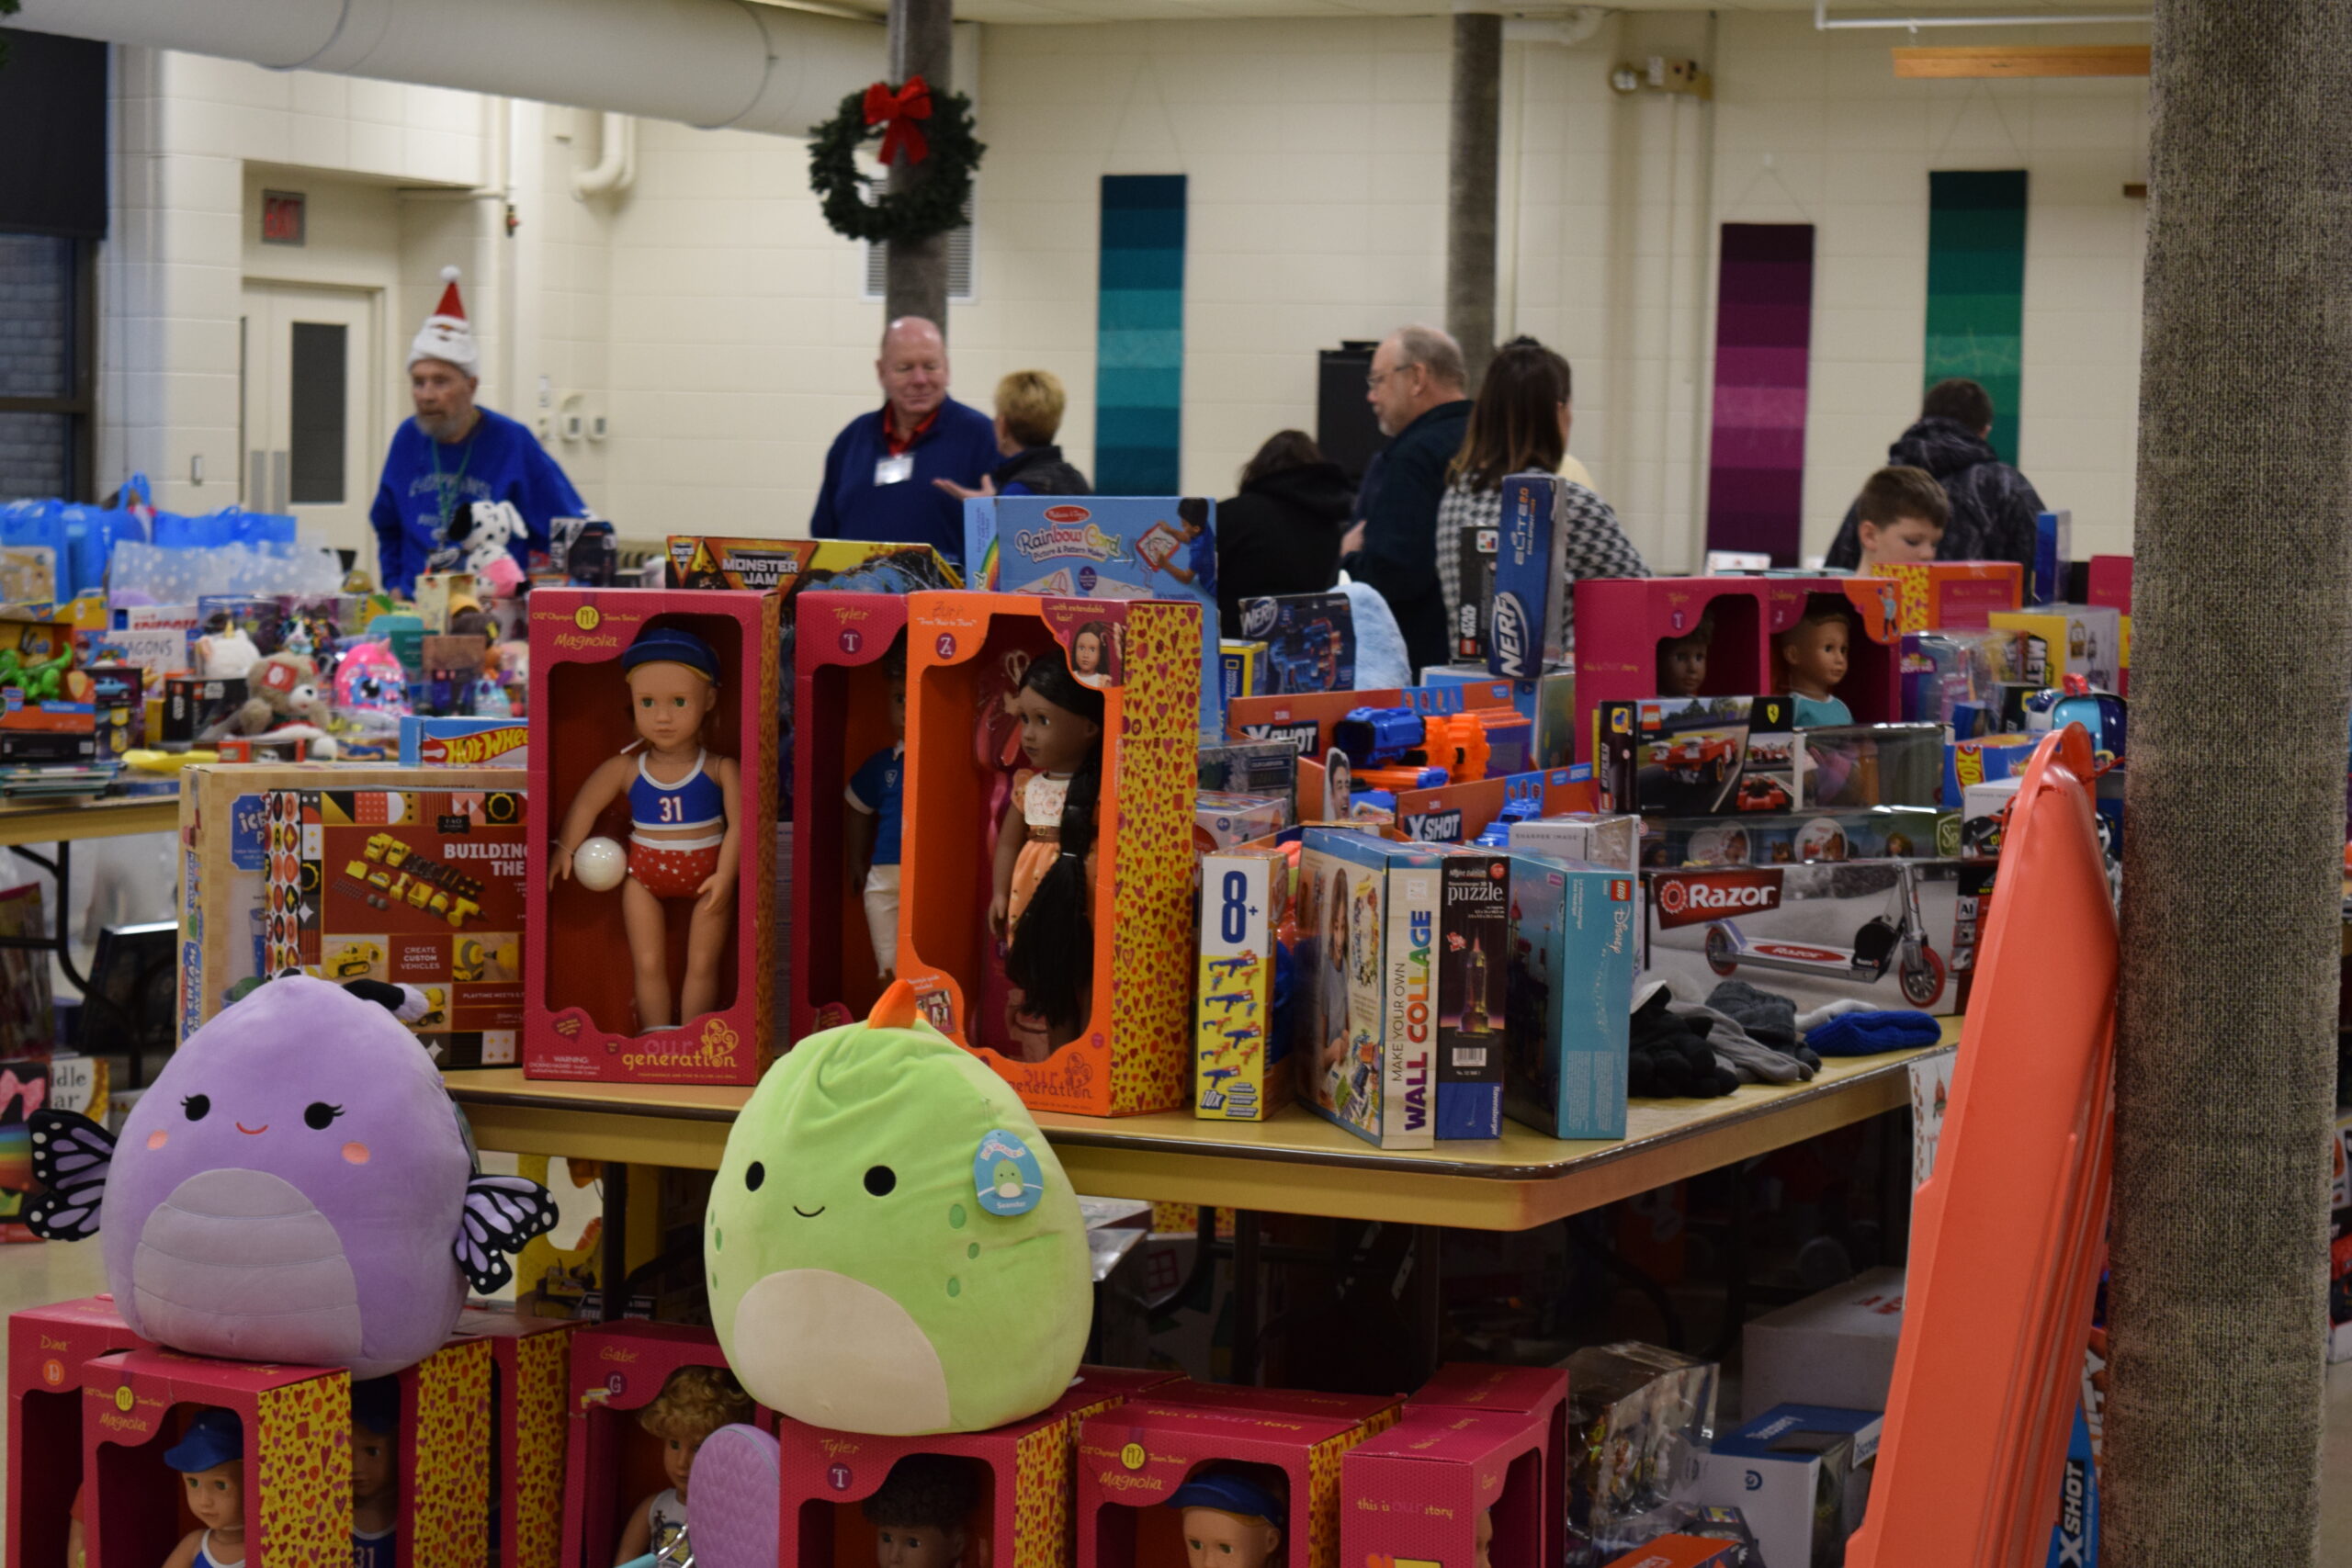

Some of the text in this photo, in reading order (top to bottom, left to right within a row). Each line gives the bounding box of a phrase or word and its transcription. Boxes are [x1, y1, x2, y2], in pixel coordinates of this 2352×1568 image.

[1017, 525, 1082, 553] Rainbow
[722, 558, 798, 573] MONSTER
[743, 573, 778, 585] JAM
[833, 606, 869, 625] Tyler
[1244, 601, 1277, 634] NERF
[553, 633, 618, 649] Magnolia
[842, 634, 859, 651] T
[939, 637, 952, 654] Z
[1495, 595, 1524, 677] NERF
[442, 736, 483, 762] HOT
[659, 795, 683, 822] 31
[491, 861, 526, 875] THE
[1448, 882, 1503, 906] puzzle
[1617, 880, 1625, 899] LEGO
[1690, 884, 1777, 908] Razor
[1772, 946, 1823, 958] Razor
[1392, 963, 1405, 1081] MAKE YOUR OWN
[1405, 910, 1431, 1131] WALL COLLAGE
[644, 1040, 694, 1056] our
[622, 1050, 738, 1071] generation
[600, 1346, 639, 1363] Gabe
[609, 1375, 622, 1393] G
[99, 1413, 147, 1432] Magnolia
[820, 1438, 860, 1459] Tyler
[832, 1468, 848, 1487] T
[1099, 1471, 1164, 1491] Magnolia
[1357, 1497, 1378, 1511] this
[1381, 1499, 1390, 1512] is
[1425, 1504, 1453, 1520] story
